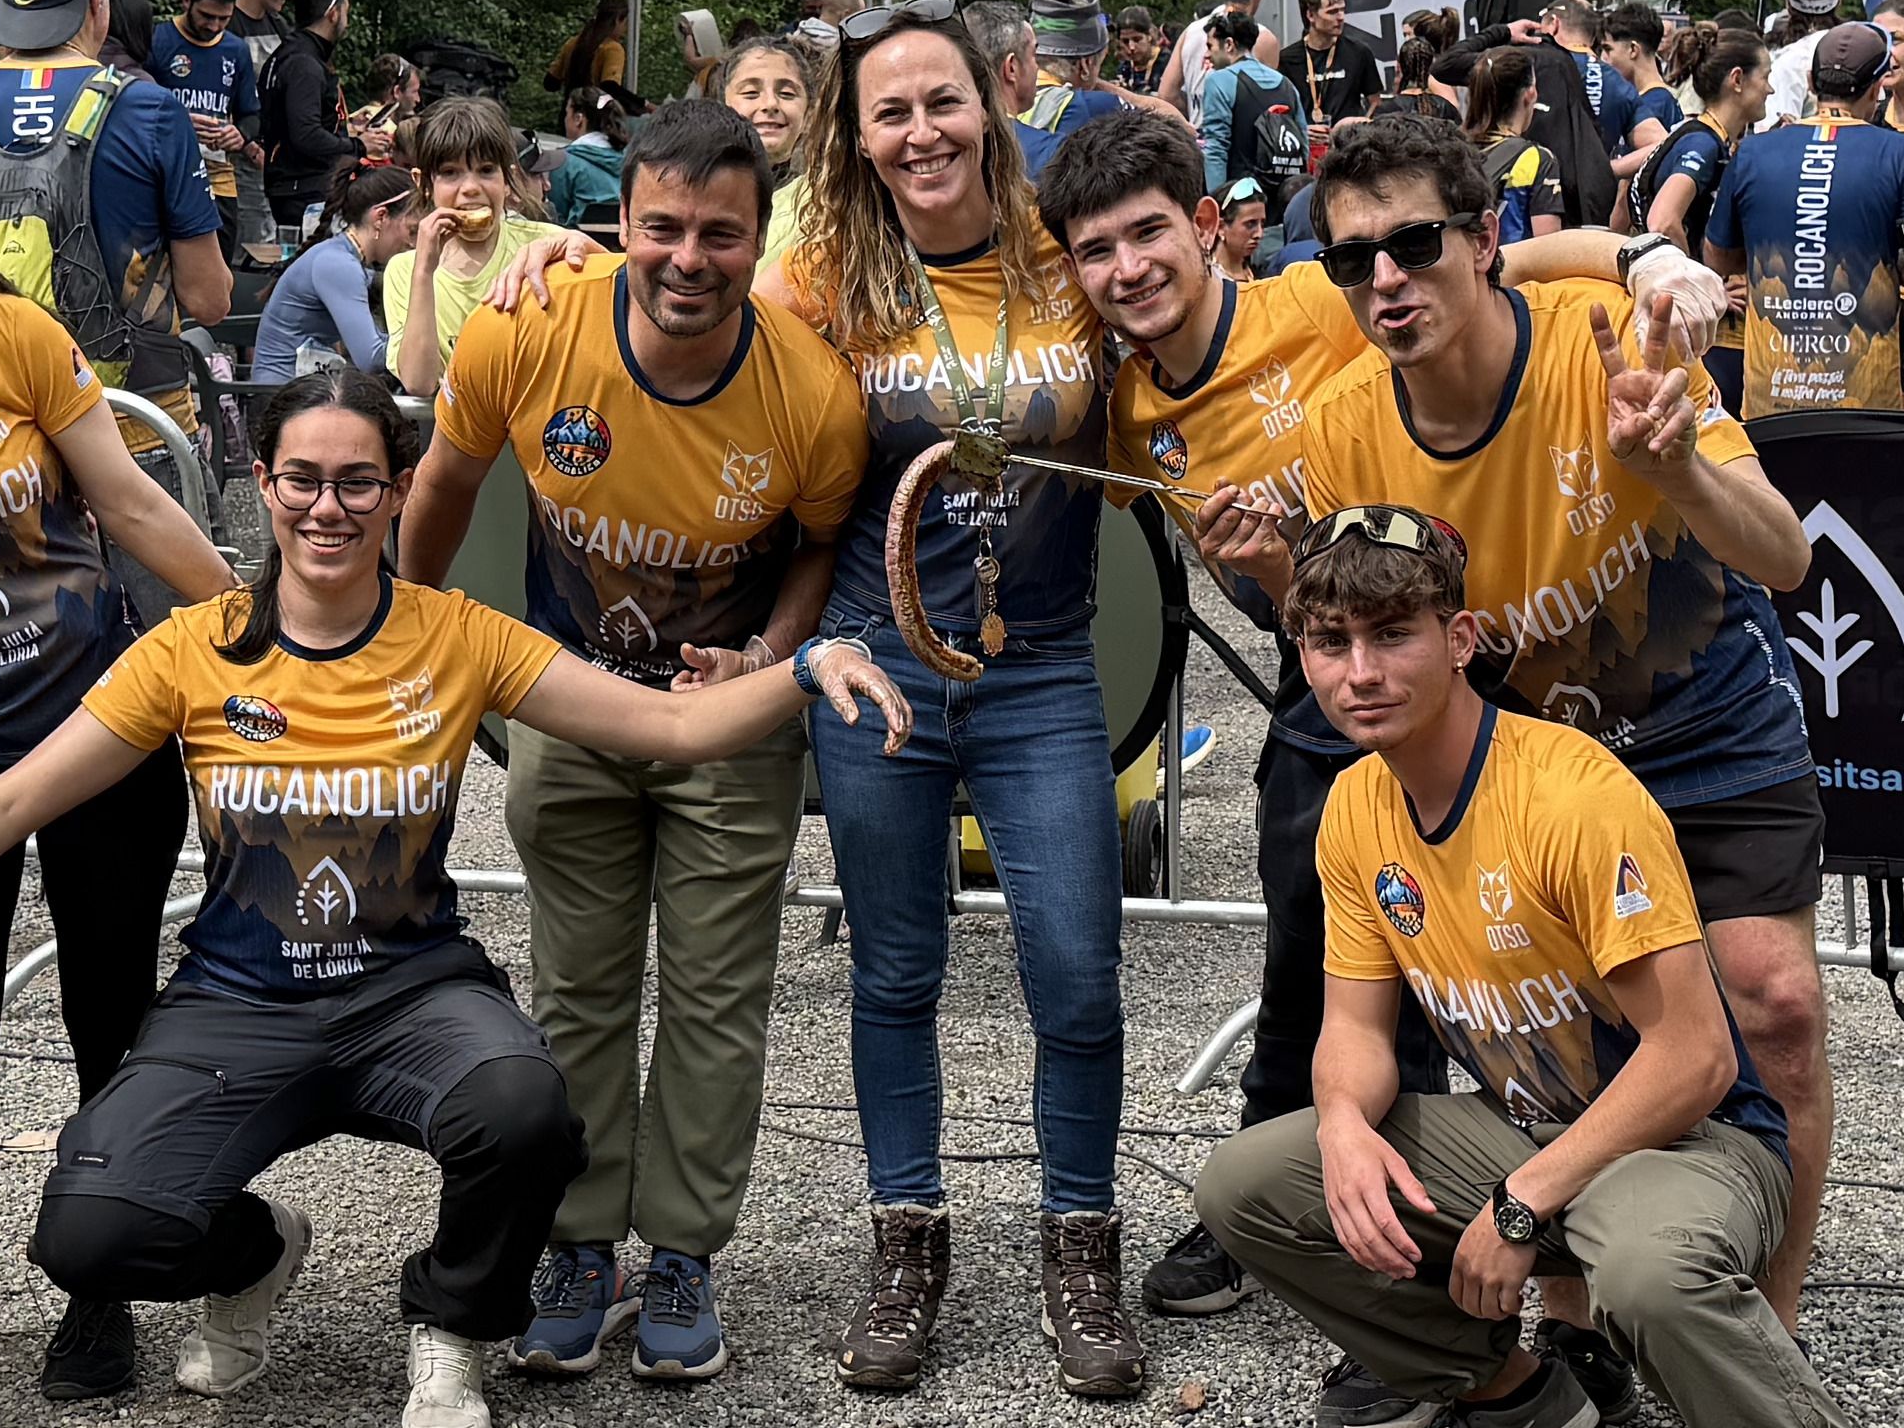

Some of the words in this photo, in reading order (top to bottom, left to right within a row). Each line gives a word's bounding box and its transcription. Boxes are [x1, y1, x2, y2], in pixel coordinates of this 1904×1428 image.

[1795, 143, 1838, 289] ROCANOLICH
[1764, 296, 1833, 311] E.Leclerc
[1262, 403, 1305, 440] OTSO
[715, 495, 763, 522] OTSO
[947, 512, 967, 526] DE
[1566, 494, 1616, 537] OTSO
[396, 710, 441, 740] OTSO
[211, 761, 449, 818] ROCANOLICH
[281, 939, 321, 959] SANT
[1485, 923, 1532, 952] OTSO
[292, 964, 313, 979] DE
[315, 956, 365, 978] LÒRIA
